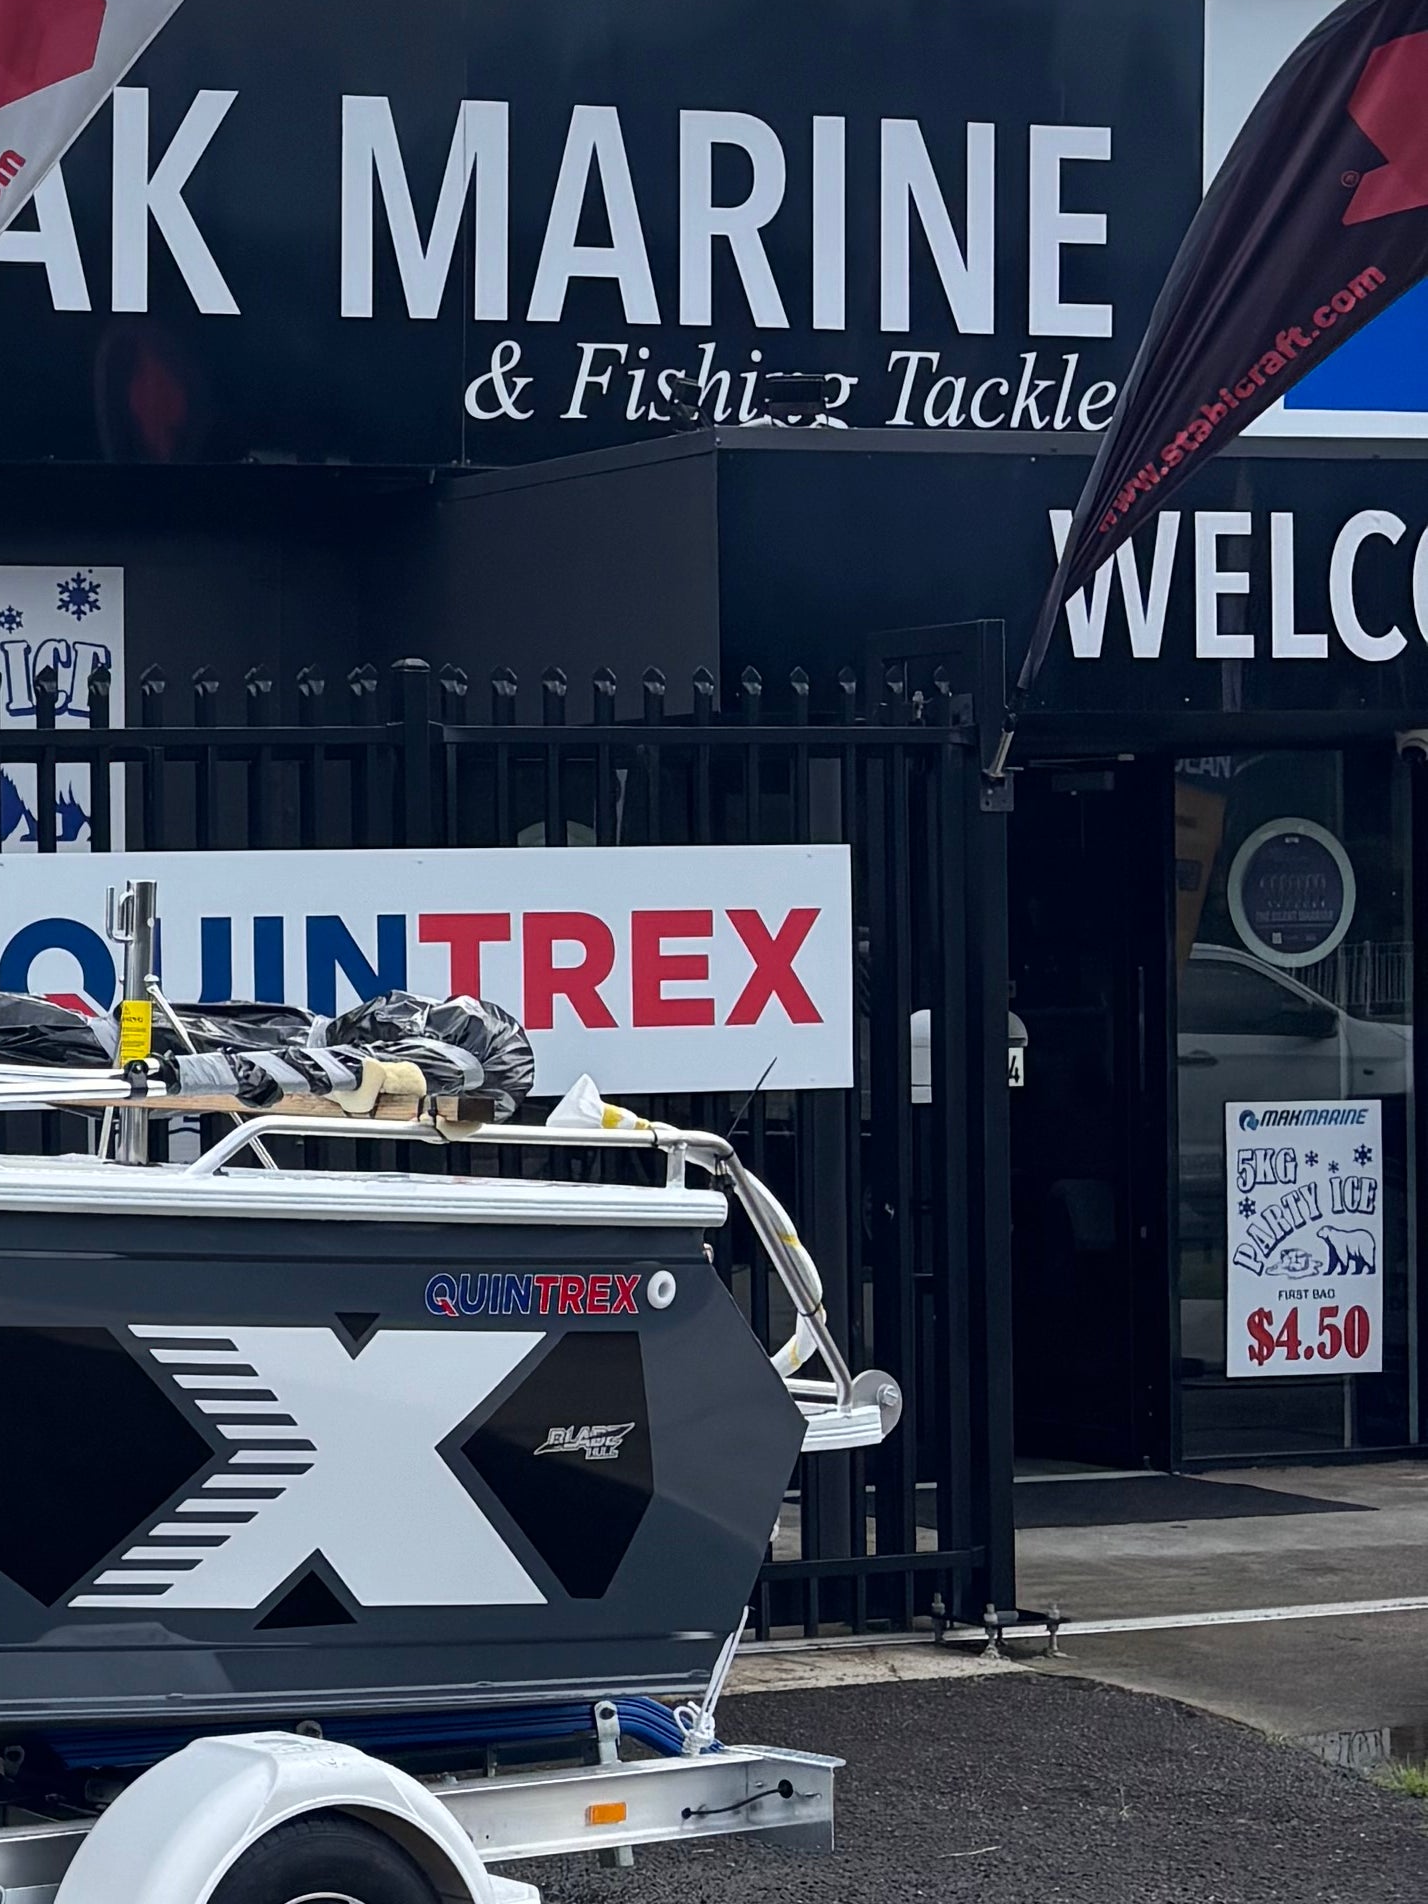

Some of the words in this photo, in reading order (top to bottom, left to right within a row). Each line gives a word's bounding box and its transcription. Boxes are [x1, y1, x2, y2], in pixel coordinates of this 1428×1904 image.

[341, 93, 1112, 339] MARINE
[464, 339, 535, 420] &
[560, 342, 859, 427] Fishig
[885, 350, 1118, 430] Tackle
[1259, 1108, 1369, 1127] MAKMARINE
[1236, 1147, 1298, 1194] 5KG
[1232, 1181, 1323, 1277] PARTY
[1329, 1175, 1378, 1215] ICE
[424, 1271, 642, 1317] QUINTREX
[1278, 1288, 1309, 1301] FIRST
[1246, 1304, 1370, 1367] $4.50
